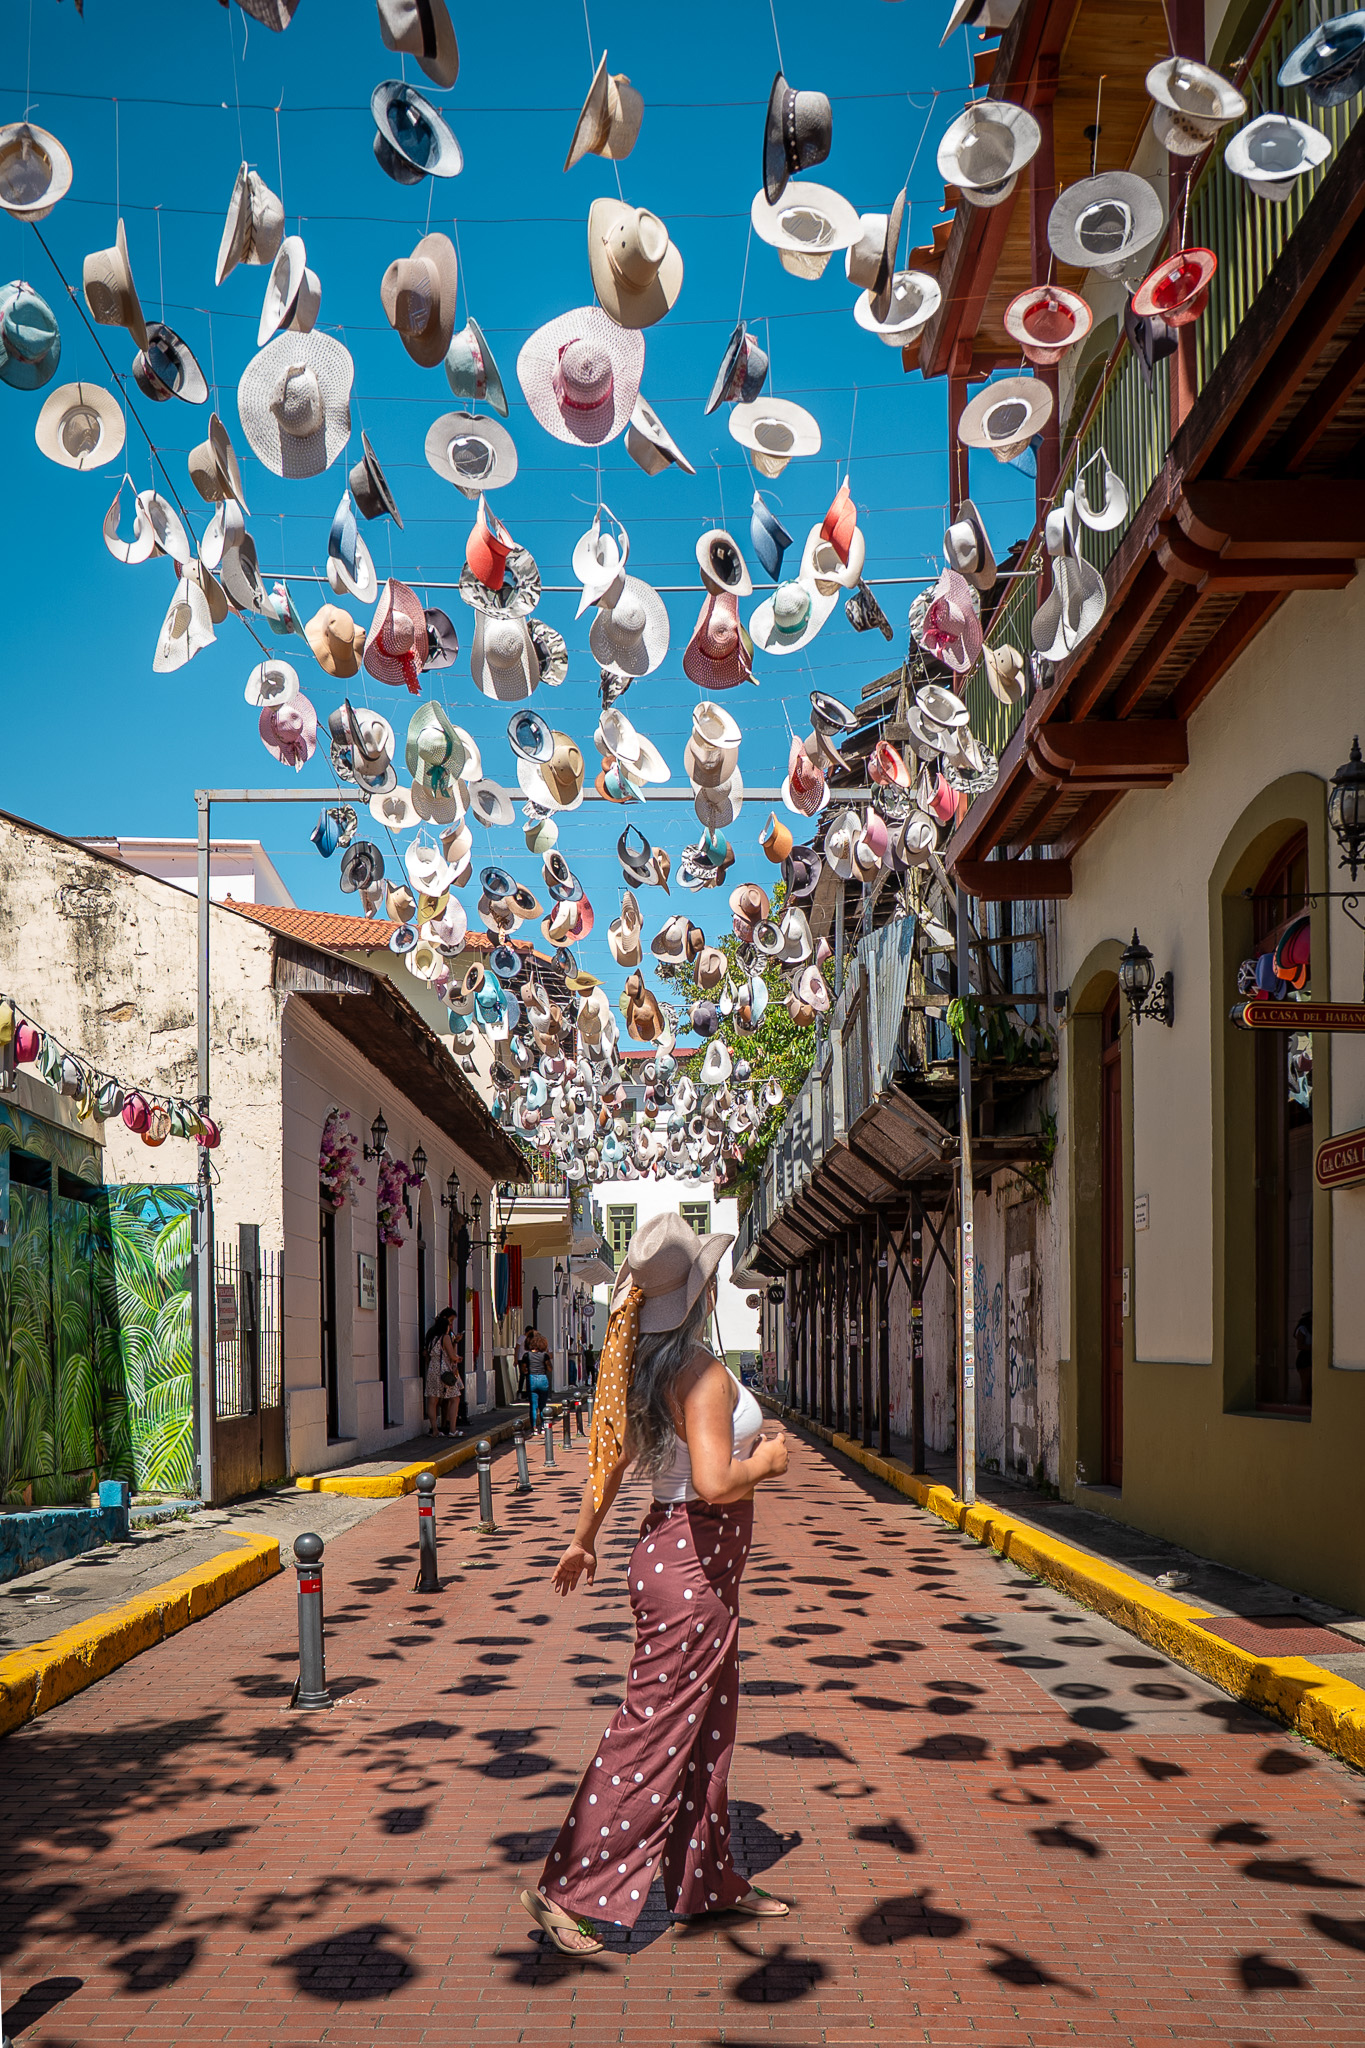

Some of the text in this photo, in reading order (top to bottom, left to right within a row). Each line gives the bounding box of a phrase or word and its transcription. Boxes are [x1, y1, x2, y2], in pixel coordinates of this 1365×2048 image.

[1254, 1011, 1267, 1020] LA
[1269, 1010, 1299, 1021] CASA
[1303, 1012, 1322, 1021] DEL
[1322, 1157, 1335, 1173] LA
[1334, 1147, 1360, 1169] CASA
